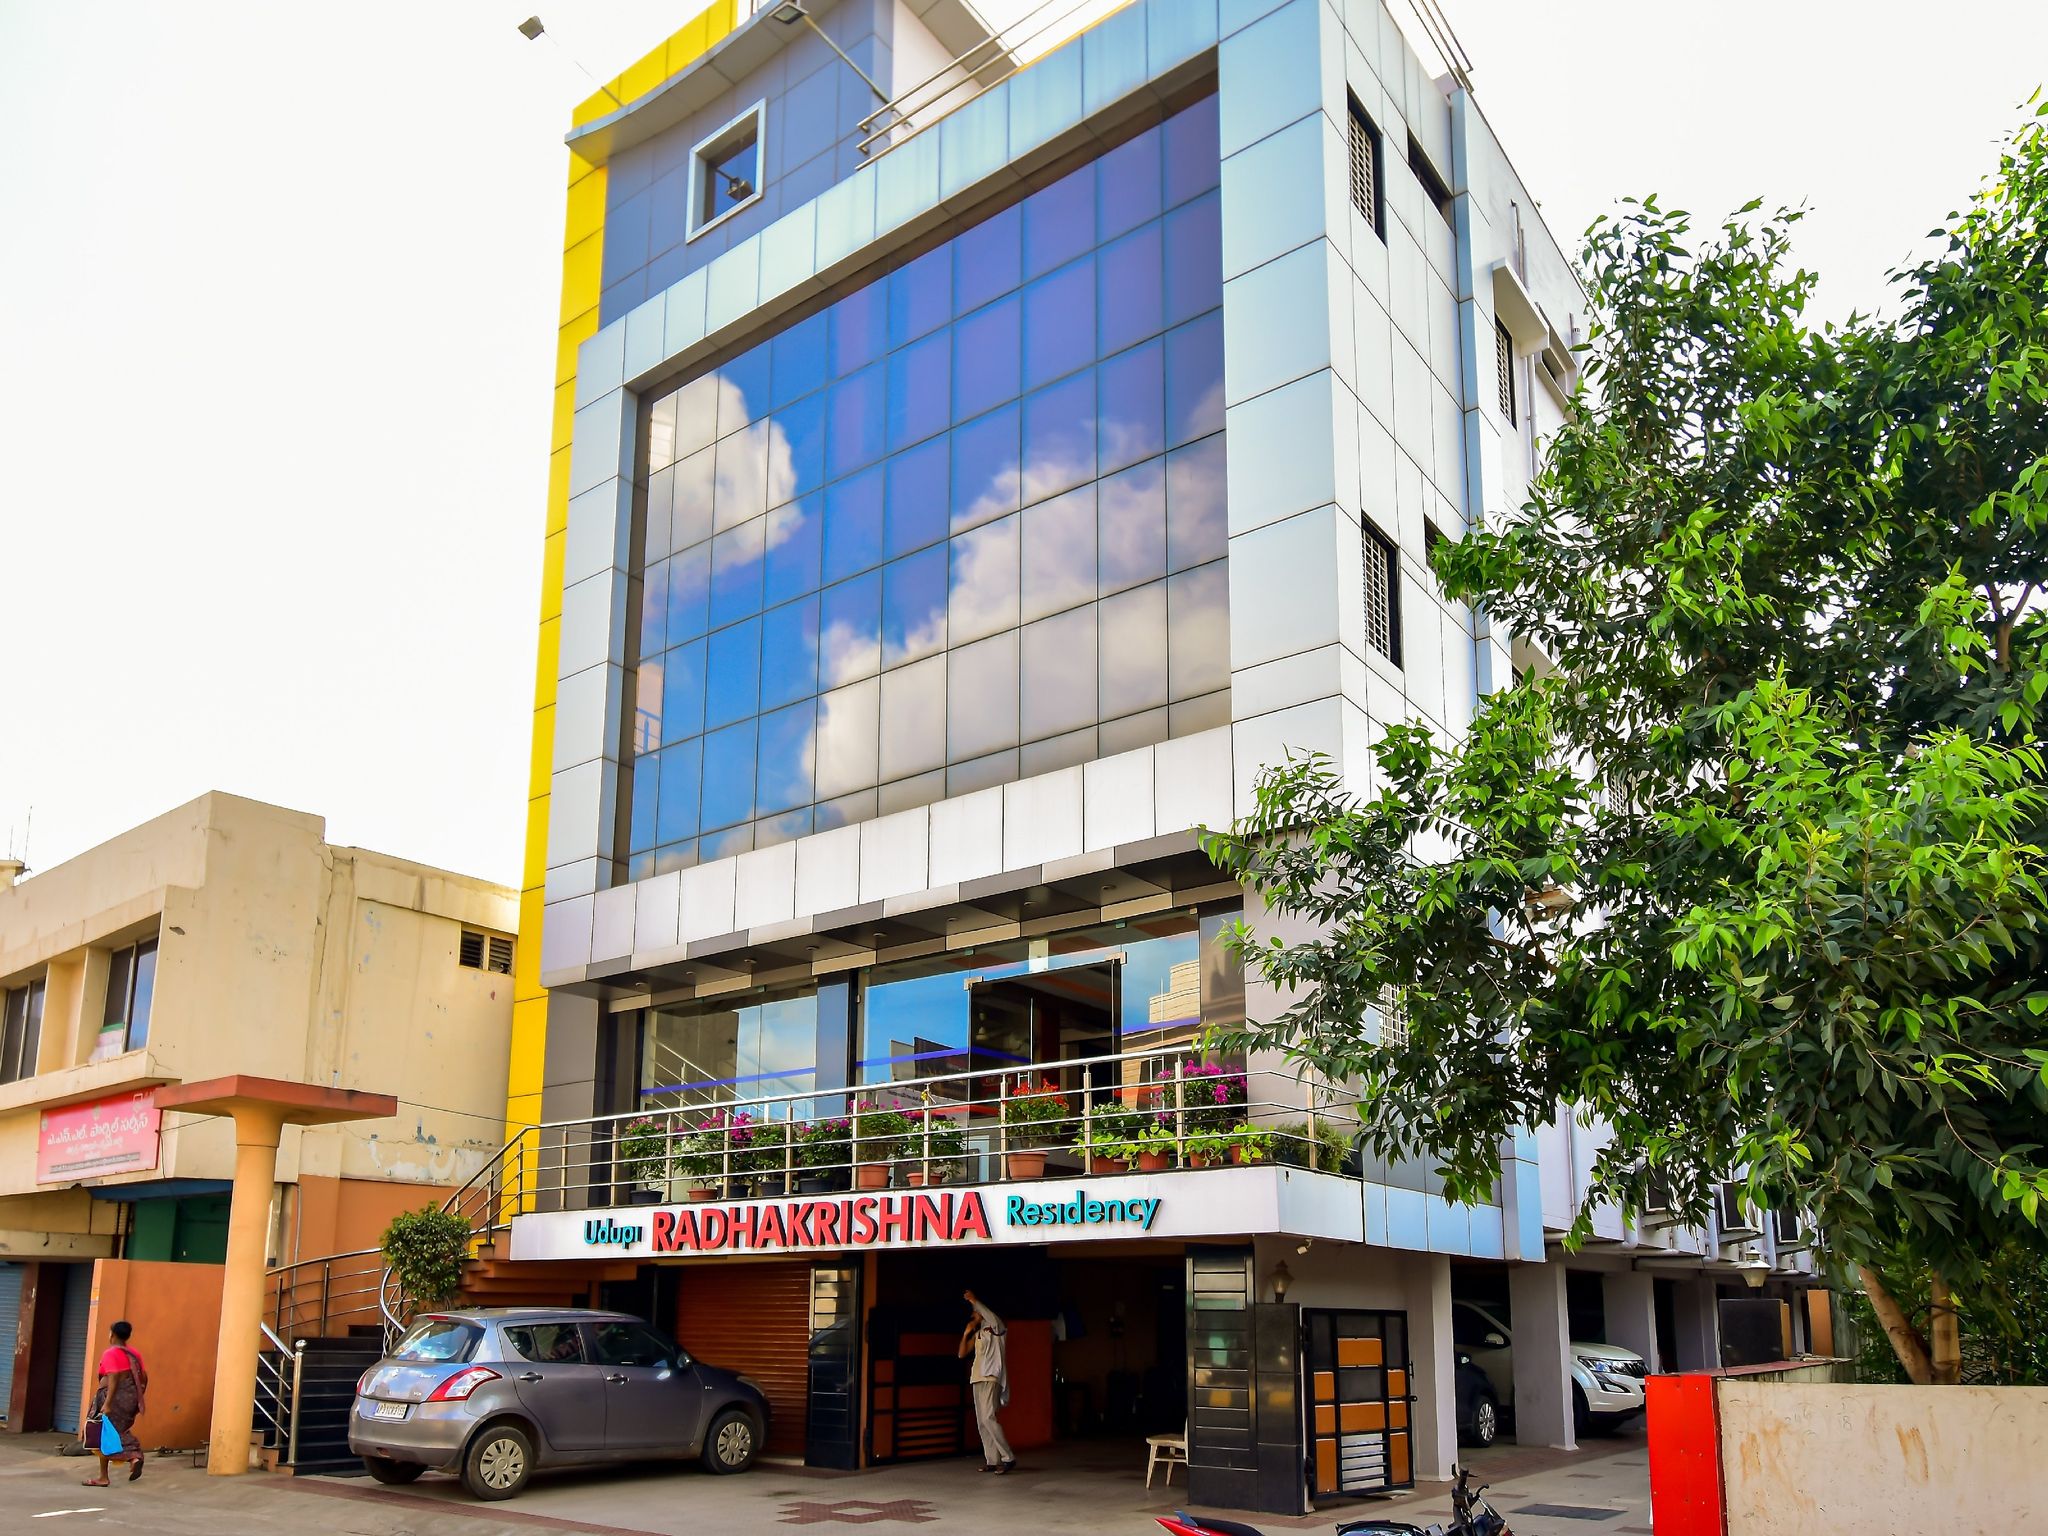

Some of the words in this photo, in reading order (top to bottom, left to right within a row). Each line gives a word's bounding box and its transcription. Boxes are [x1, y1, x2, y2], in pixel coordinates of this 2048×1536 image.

[584, 1218, 643, 1249] Udupi
[652, 1191, 992, 1252] RADHAKRISHNA
[1007, 1190, 1162, 1231] Residency
